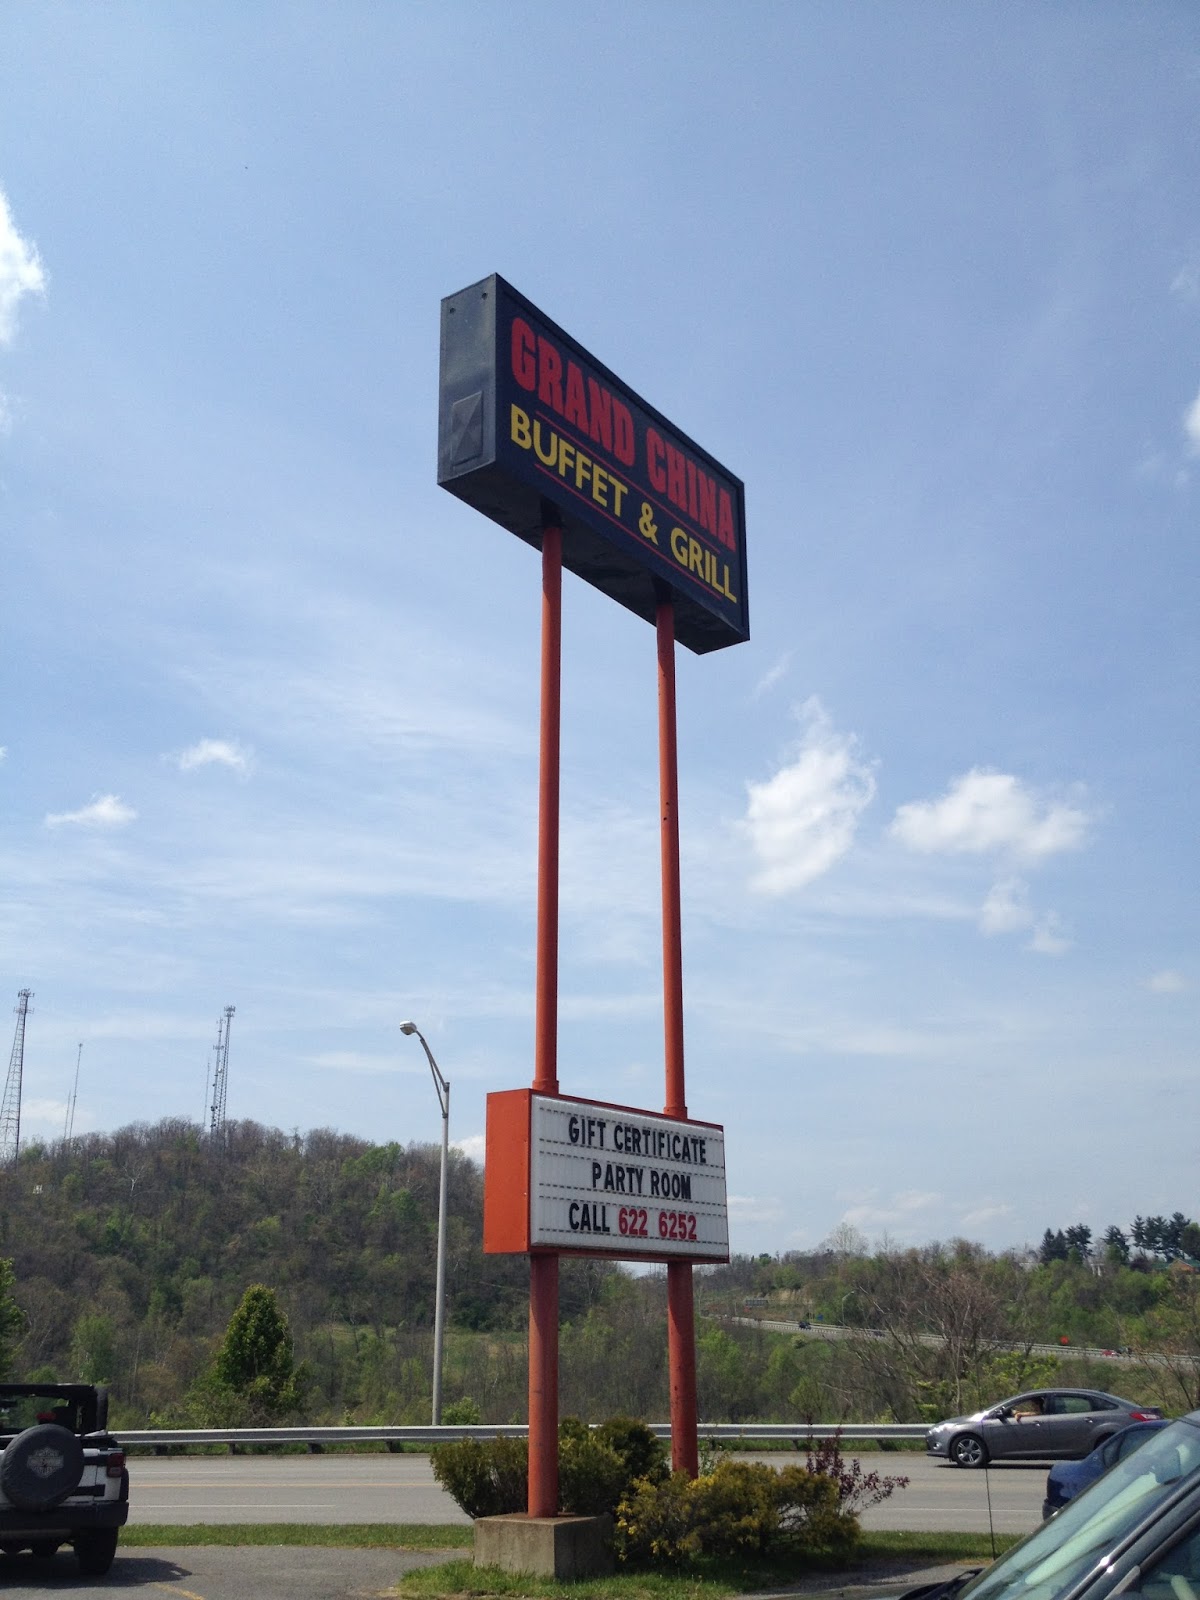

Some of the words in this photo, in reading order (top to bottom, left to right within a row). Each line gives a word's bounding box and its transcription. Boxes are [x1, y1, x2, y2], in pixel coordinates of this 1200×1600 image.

[511, 317, 635, 467] GRAND
[646, 427, 736, 551] CHINA
[510, 403, 628, 517] BUFFET
[638, 502, 659, 545] &
[670, 527, 737, 603] GRILL
[568, 1116, 606, 1147] GIFT
[614, 1124, 707, 1164] CERTIFICATE
[592, 1162, 644, 1194] PARTY
[651, 1170, 692, 1200] ROOM
[569, 1202, 610, 1232] CALL
[618, 1207, 648, 1236] 622
[658, 1211, 698, 1240] 6252
